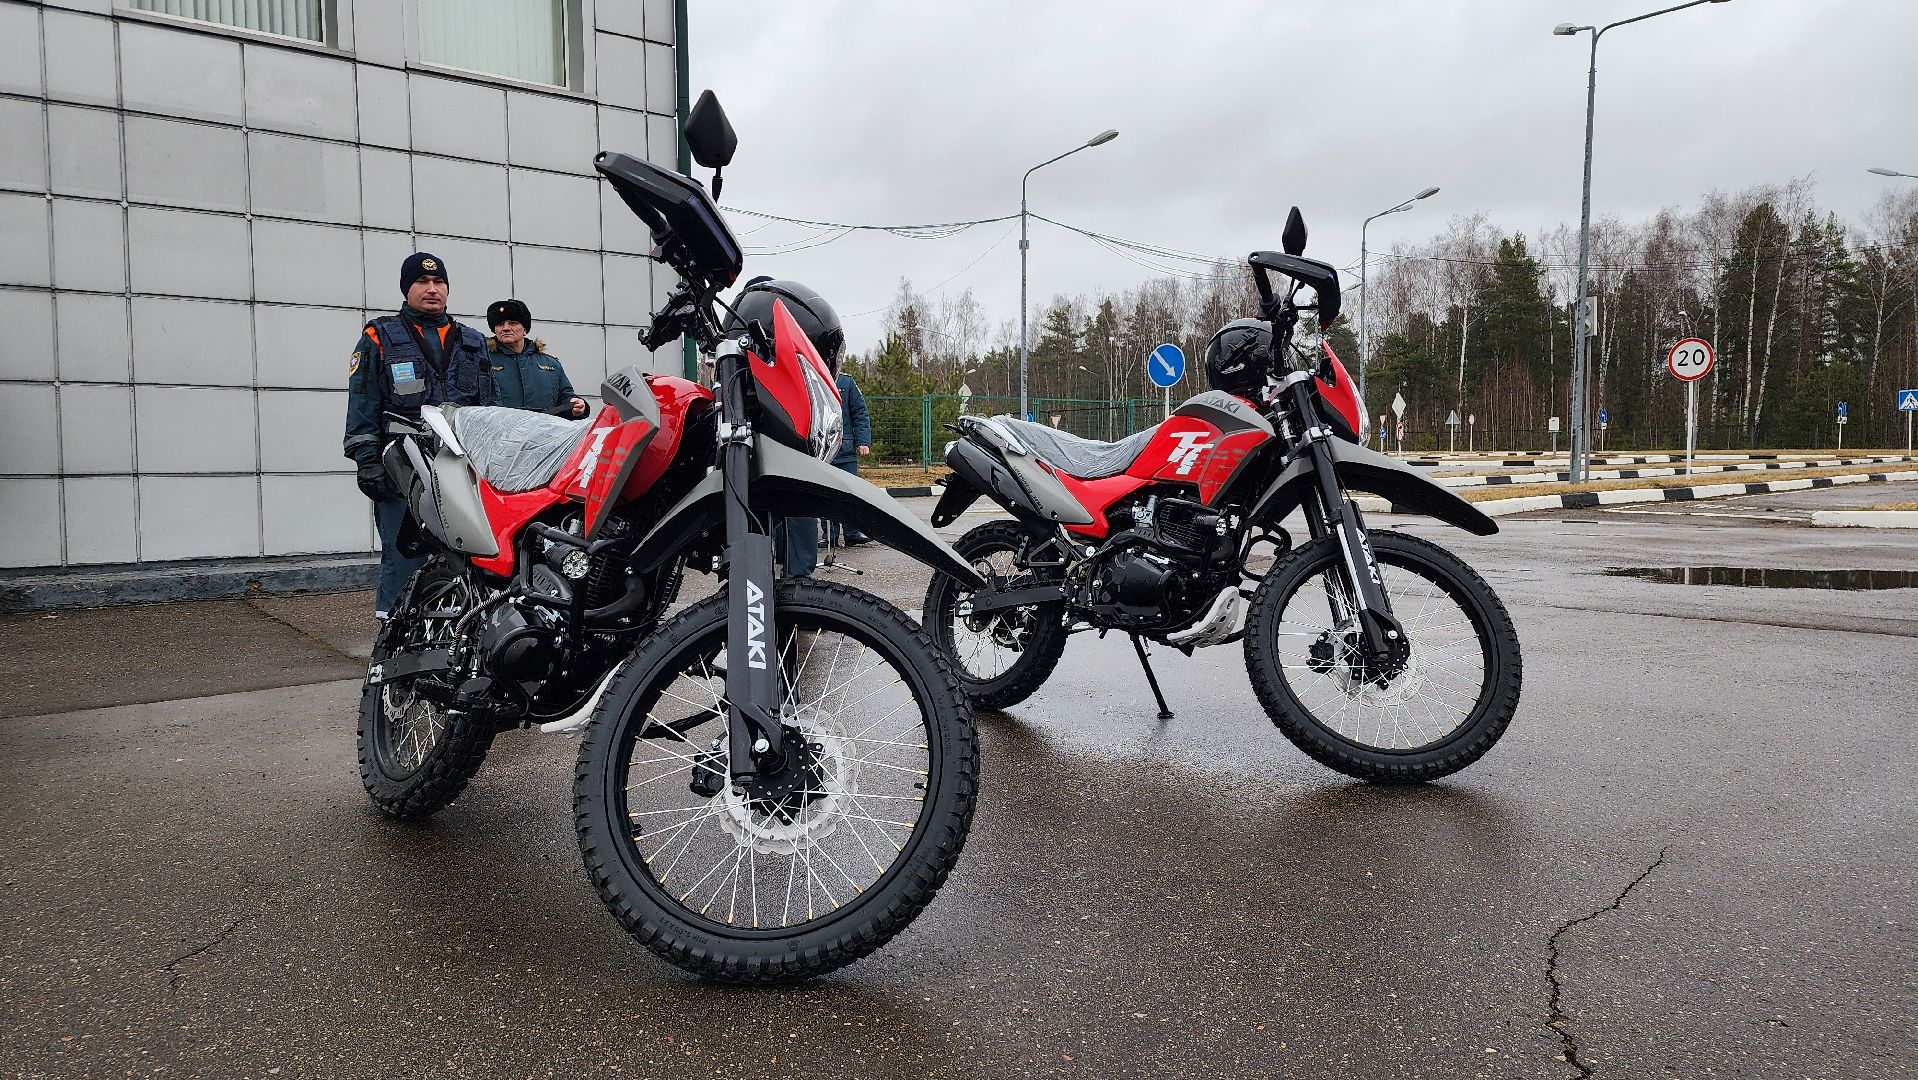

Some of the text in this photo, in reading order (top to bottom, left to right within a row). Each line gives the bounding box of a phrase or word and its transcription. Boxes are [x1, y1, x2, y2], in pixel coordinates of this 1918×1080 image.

[1677, 348, 1705, 367] 20
[1167, 431, 1215, 476] TT
[1355, 527, 1380, 585] ATAKI
[746, 579, 767, 670] ATAKI
